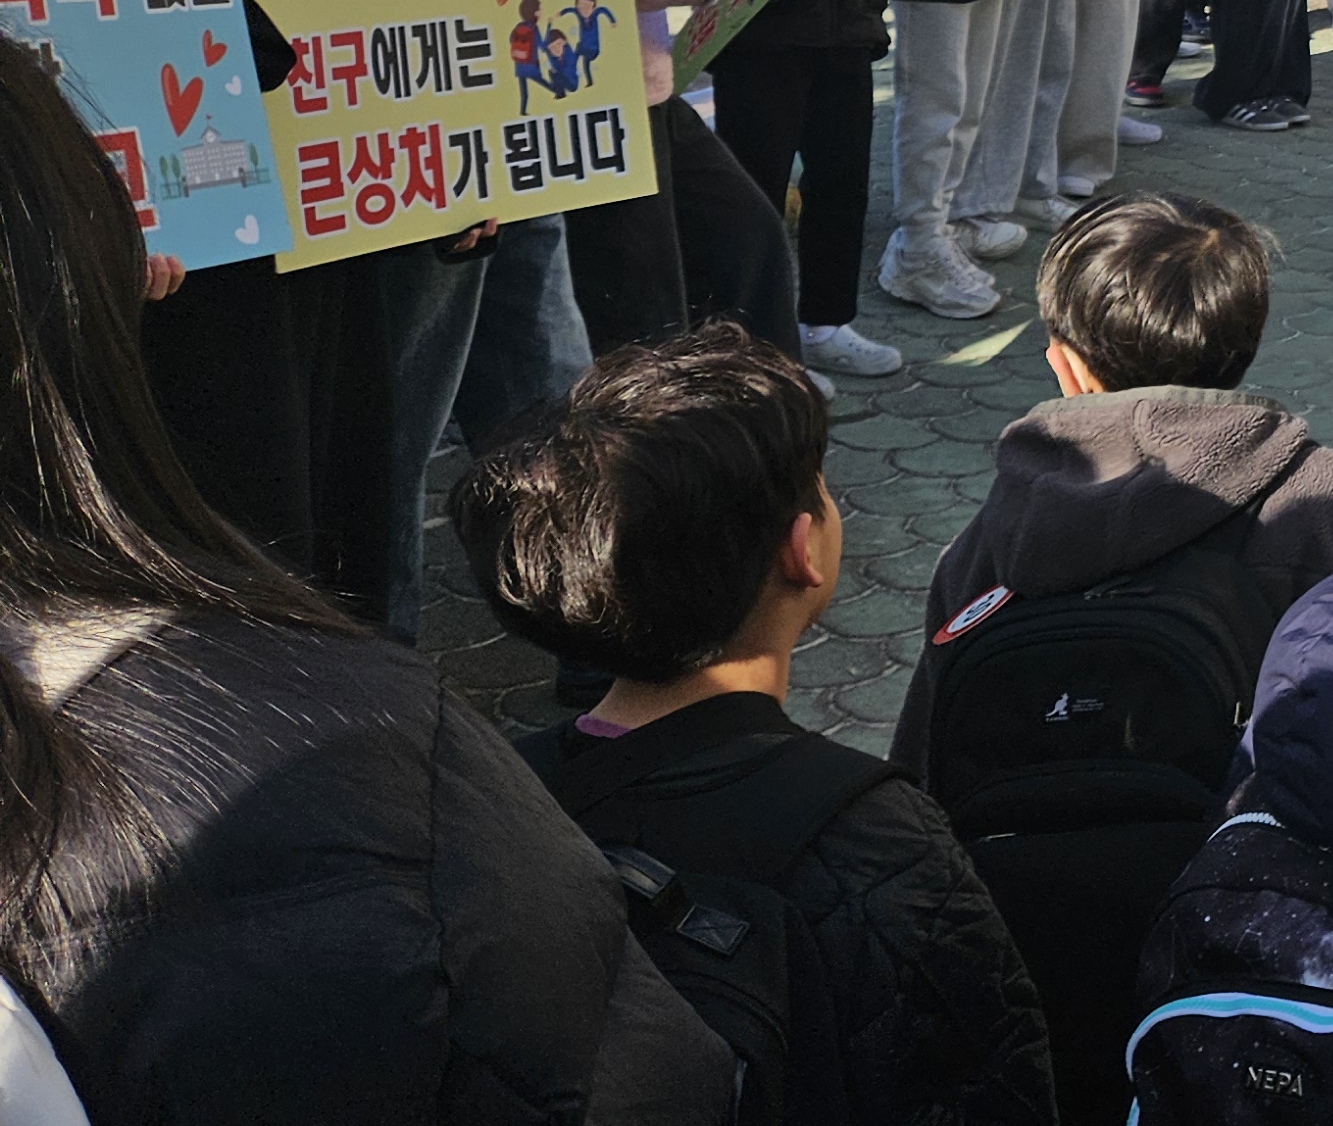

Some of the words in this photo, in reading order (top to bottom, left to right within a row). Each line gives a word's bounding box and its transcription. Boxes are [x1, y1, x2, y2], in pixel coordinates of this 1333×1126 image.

[286, 18, 494, 114] 친구에게는
[298, 123, 490, 237] 큰상처가
[503, 107, 626, 193] 됩니다
